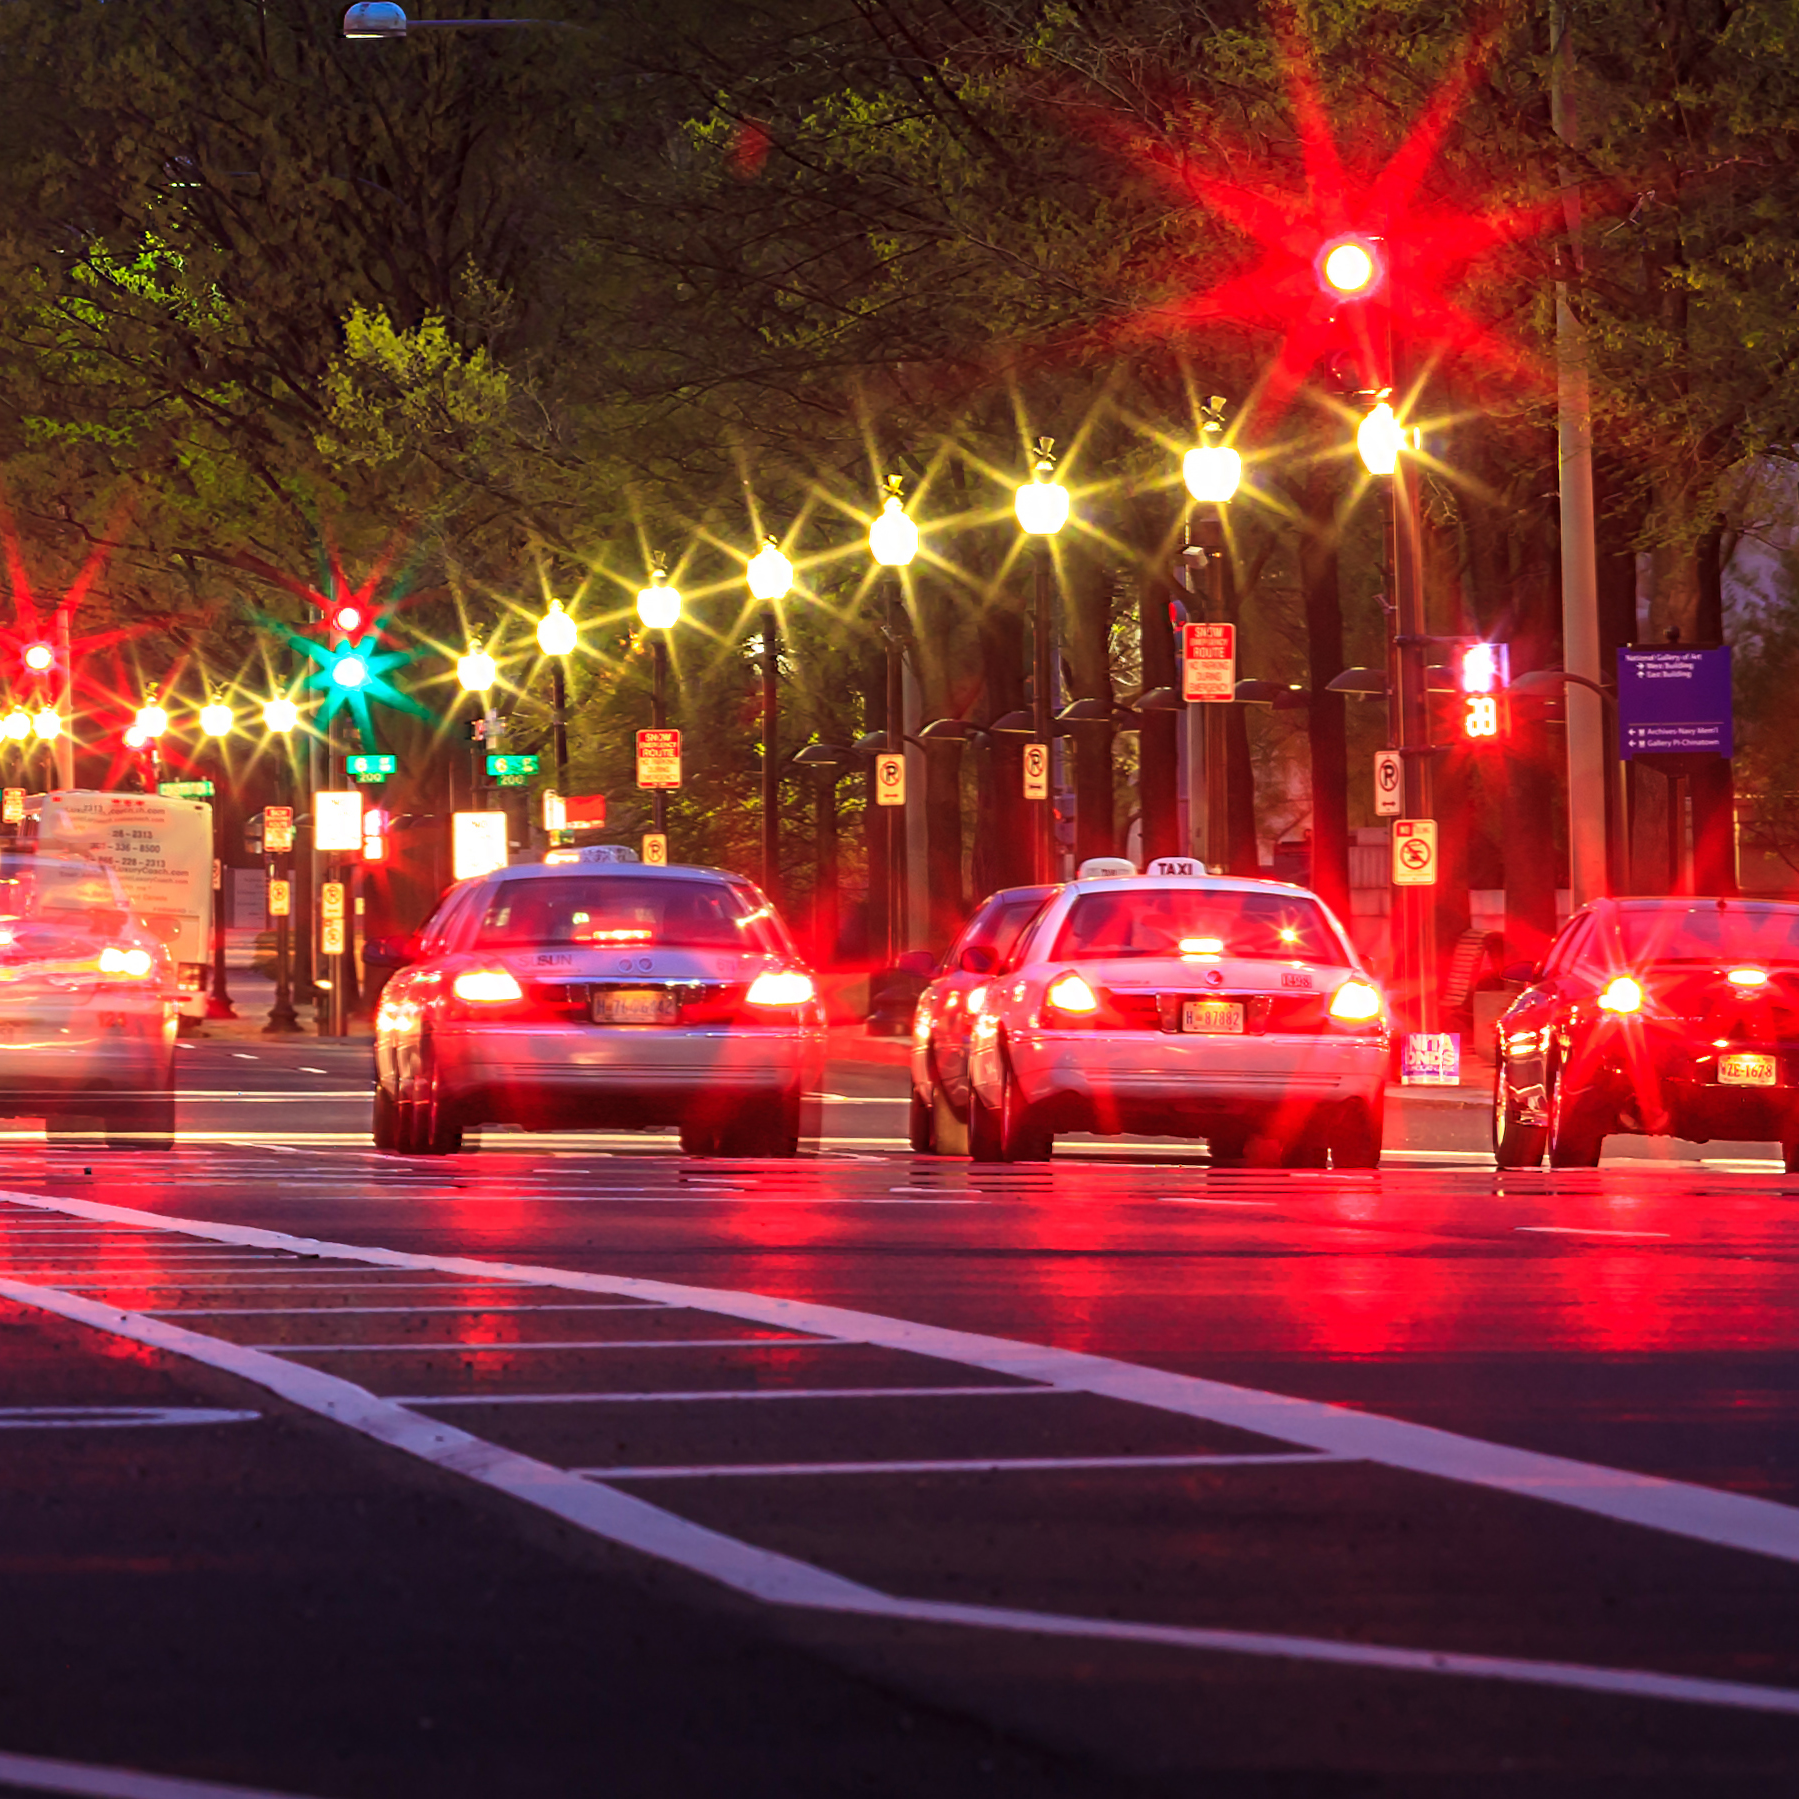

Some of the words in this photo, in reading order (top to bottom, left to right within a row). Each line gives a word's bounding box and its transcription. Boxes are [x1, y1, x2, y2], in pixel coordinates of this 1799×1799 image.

[1195, 627, 1224, 638] SNOW
[1193, 647, 1226, 658] ROUTE
[360, 773, 382, 782] 200
[500, 775, 524, 785] 200
[1159, 863, 1193, 876] TAXI
[1409, 1034, 1454, 1051] NITA
[1405, 1051, 1455, 1066] ONDS
